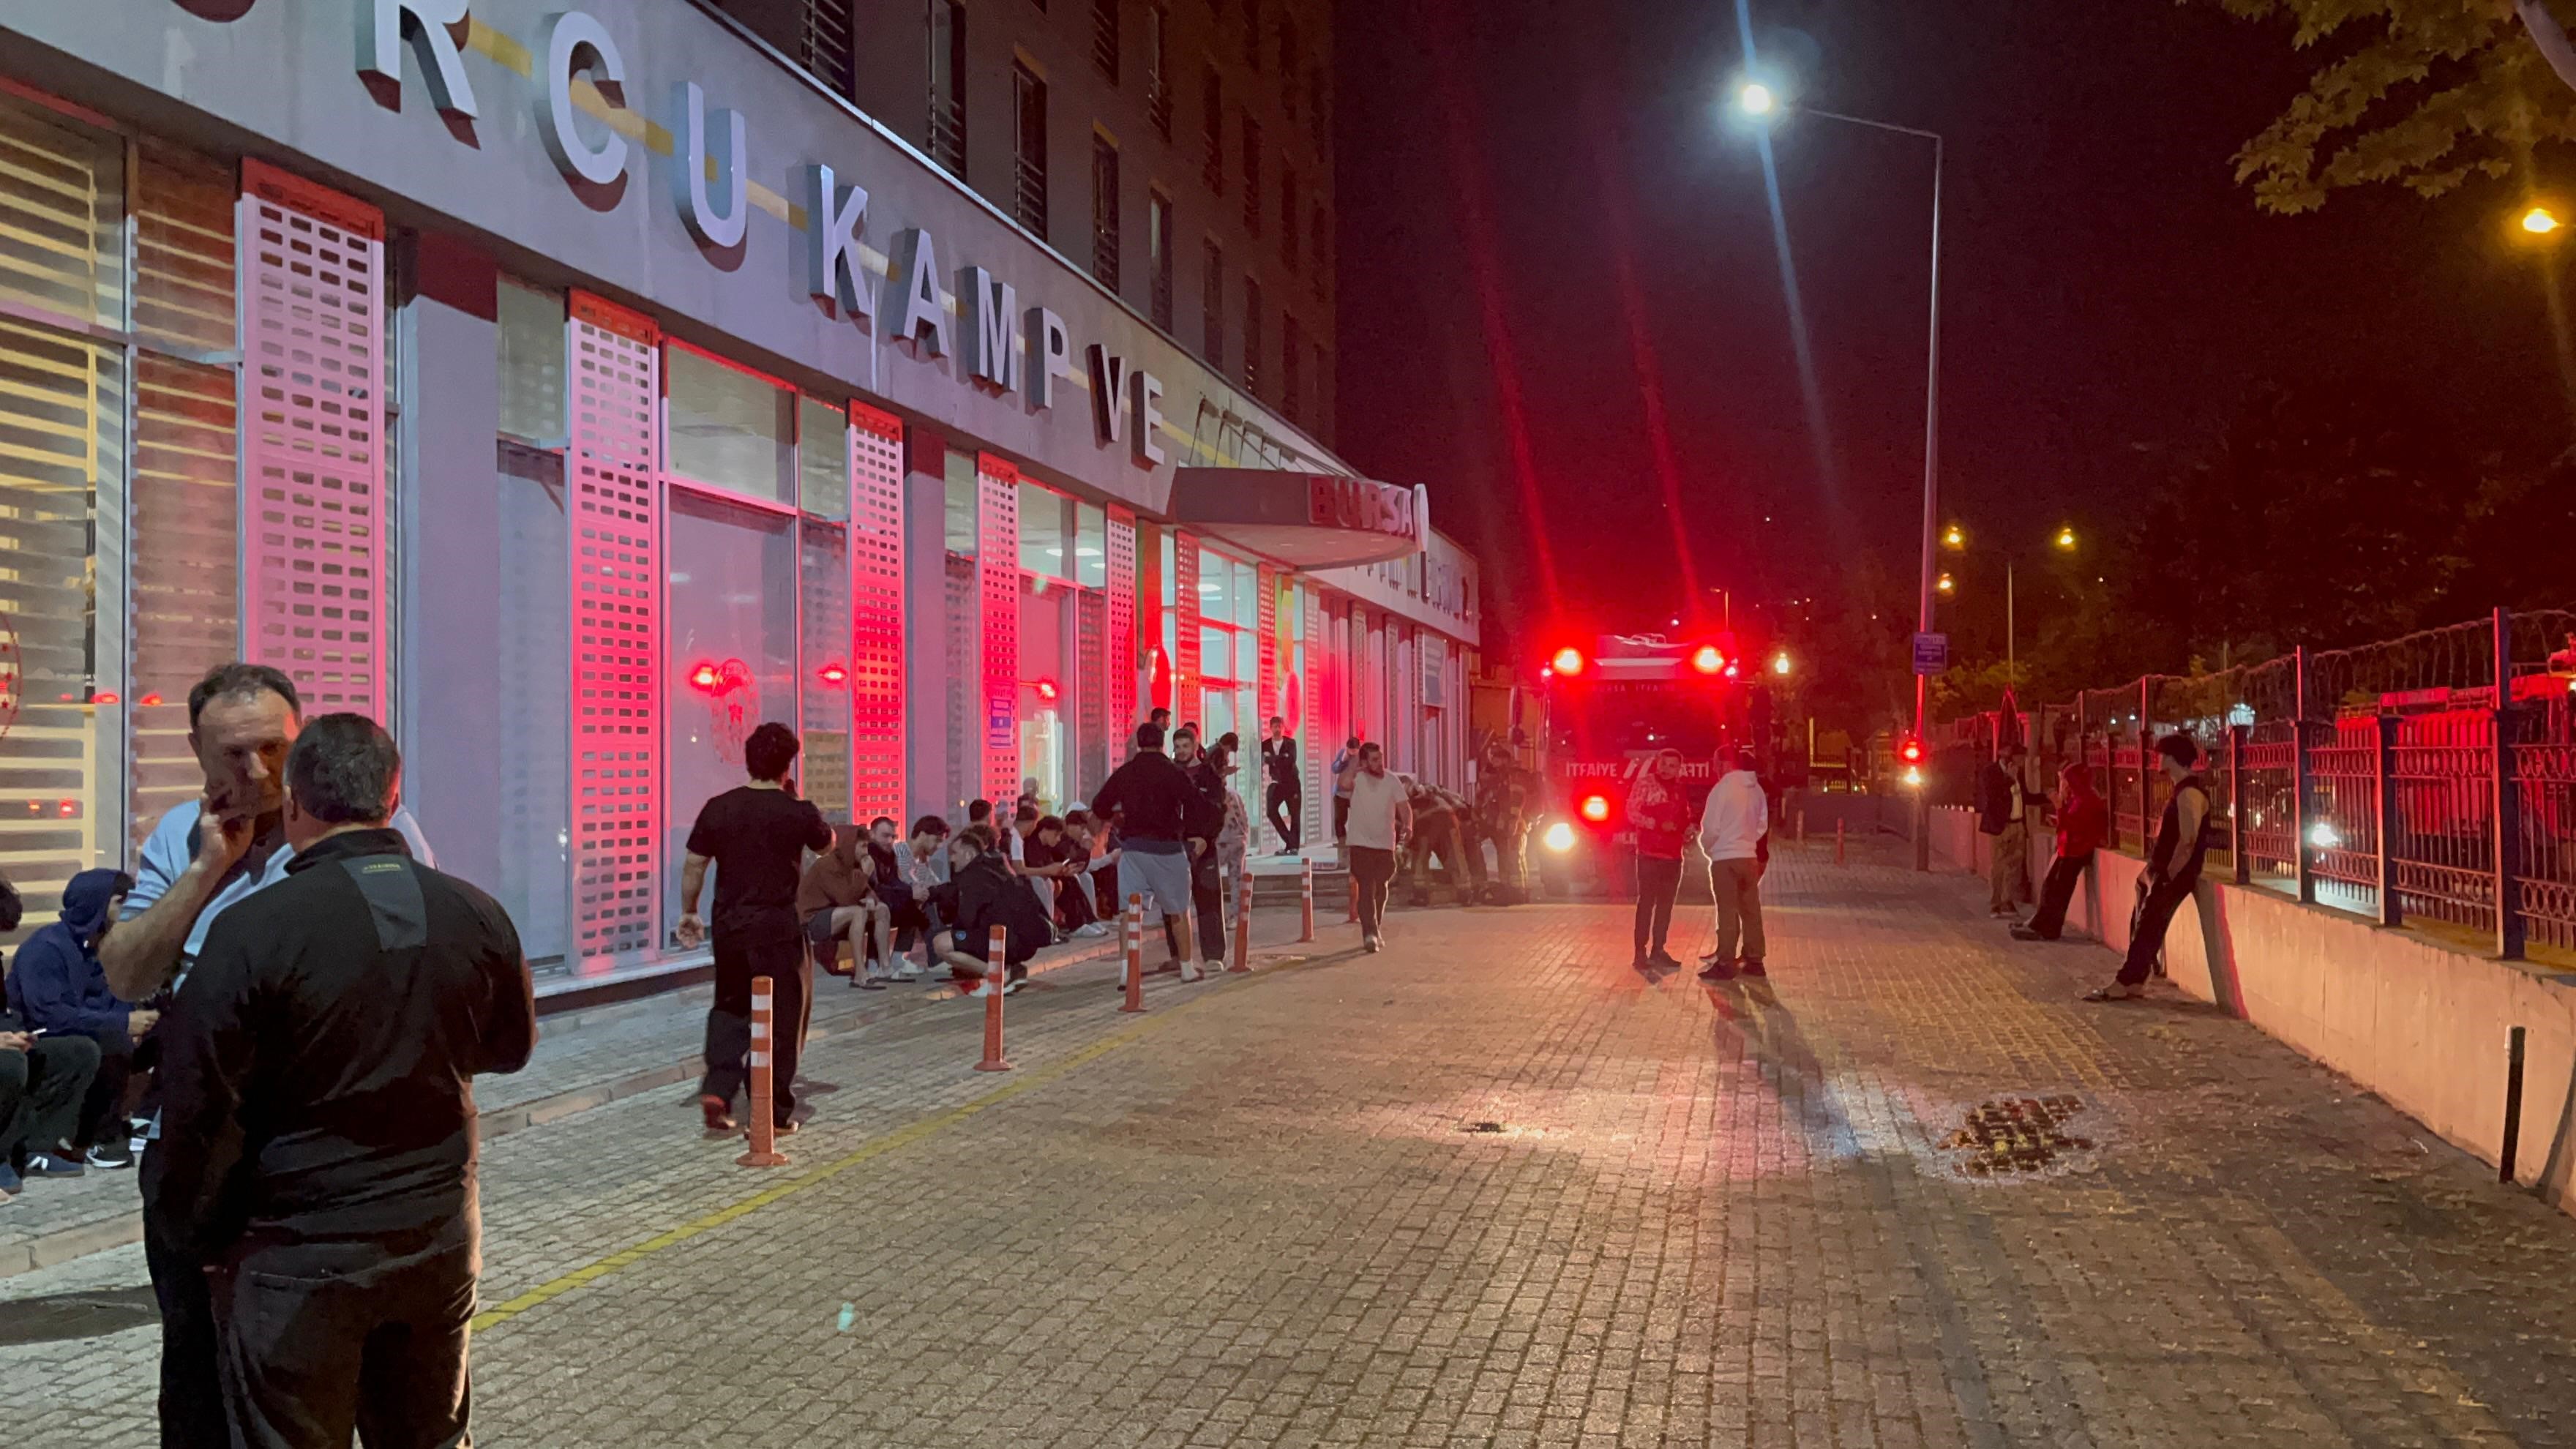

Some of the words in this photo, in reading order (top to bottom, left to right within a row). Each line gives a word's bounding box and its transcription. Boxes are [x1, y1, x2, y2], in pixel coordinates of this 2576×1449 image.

[172, 0, 746, 250] RCU
[808, 164, 1071, 411] KAMP
[1087, 343, 1165, 466] VE
[1307, 477, 1415, 537] BURSA
